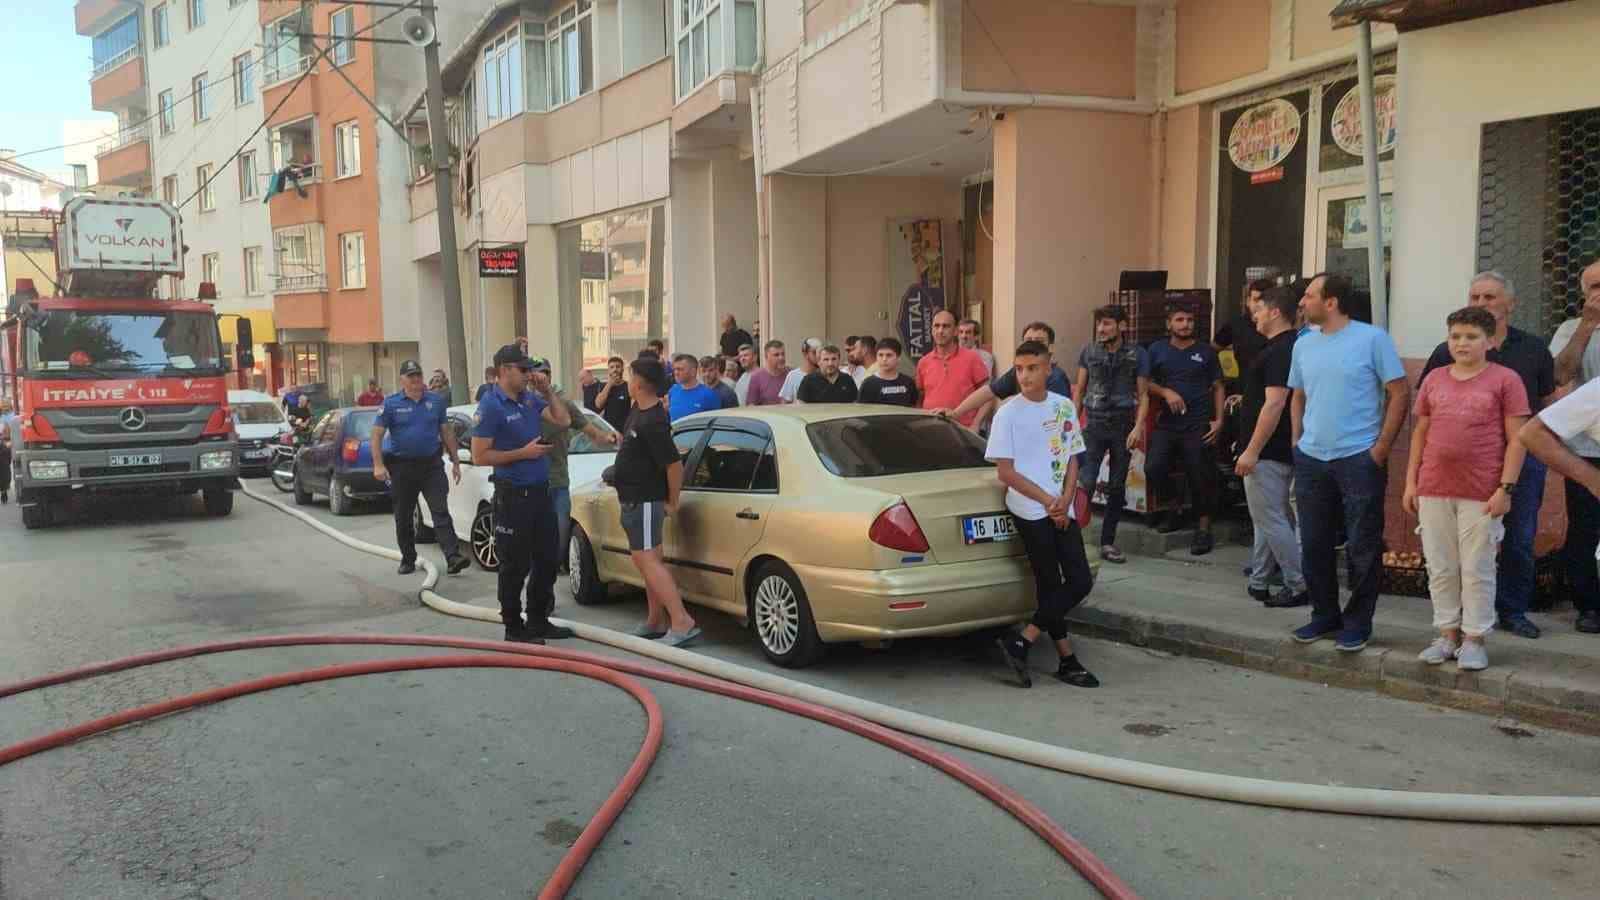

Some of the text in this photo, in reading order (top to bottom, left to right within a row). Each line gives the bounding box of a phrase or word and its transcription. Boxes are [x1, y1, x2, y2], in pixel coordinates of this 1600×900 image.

[85, 233, 165, 248] VOLKAN
[908, 290, 923, 357] FATTAL
[150, 387, 168, 398] 112
[974, 519, 986, 537] 16
